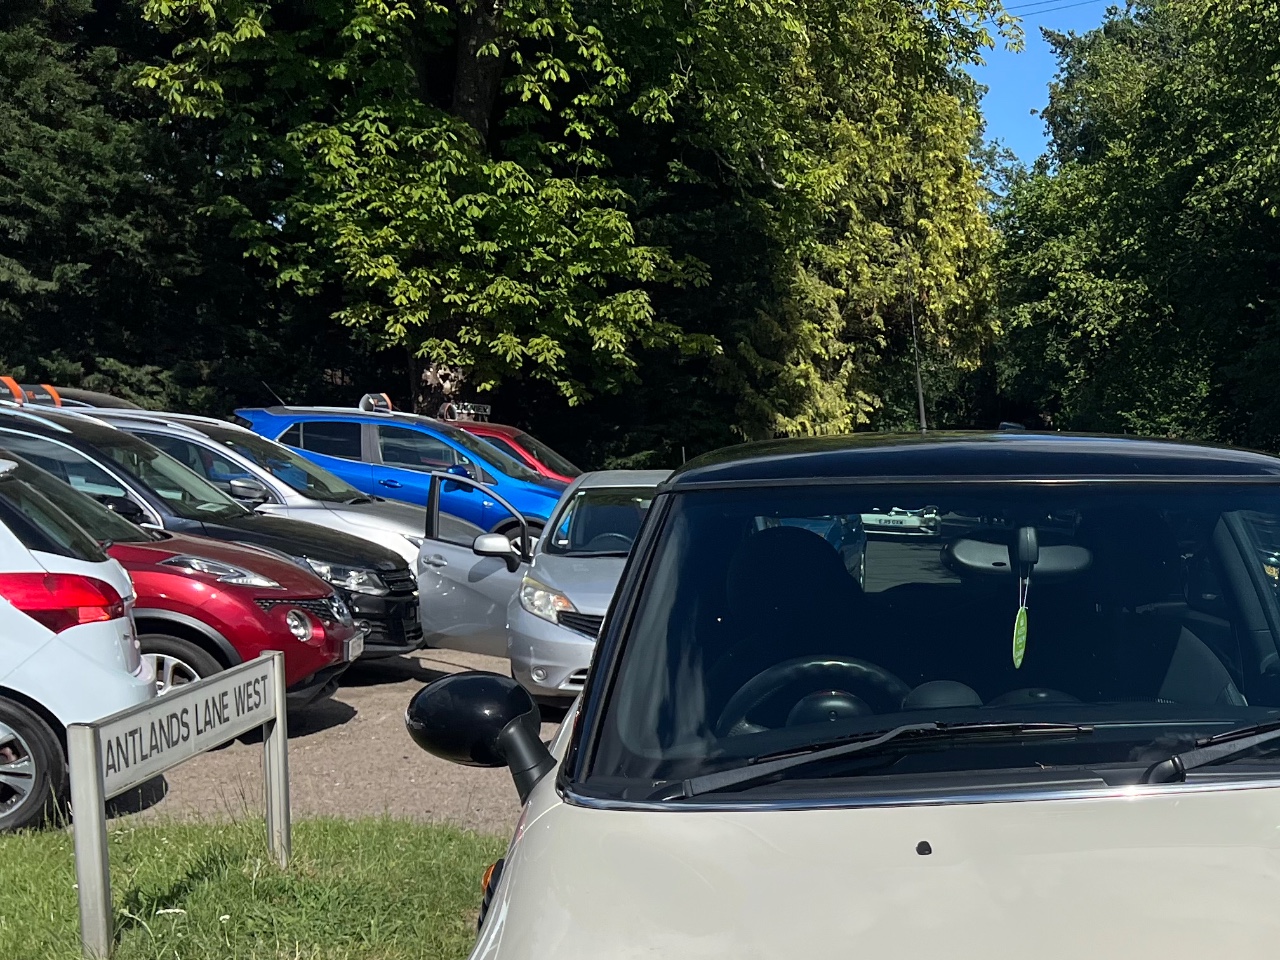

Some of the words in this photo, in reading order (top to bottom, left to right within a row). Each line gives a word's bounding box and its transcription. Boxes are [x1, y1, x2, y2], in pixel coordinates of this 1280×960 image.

[105, 707, 190, 778] ANTLANDS
[195, 690, 230, 736] LANE
[233, 674, 268, 717] WEST
